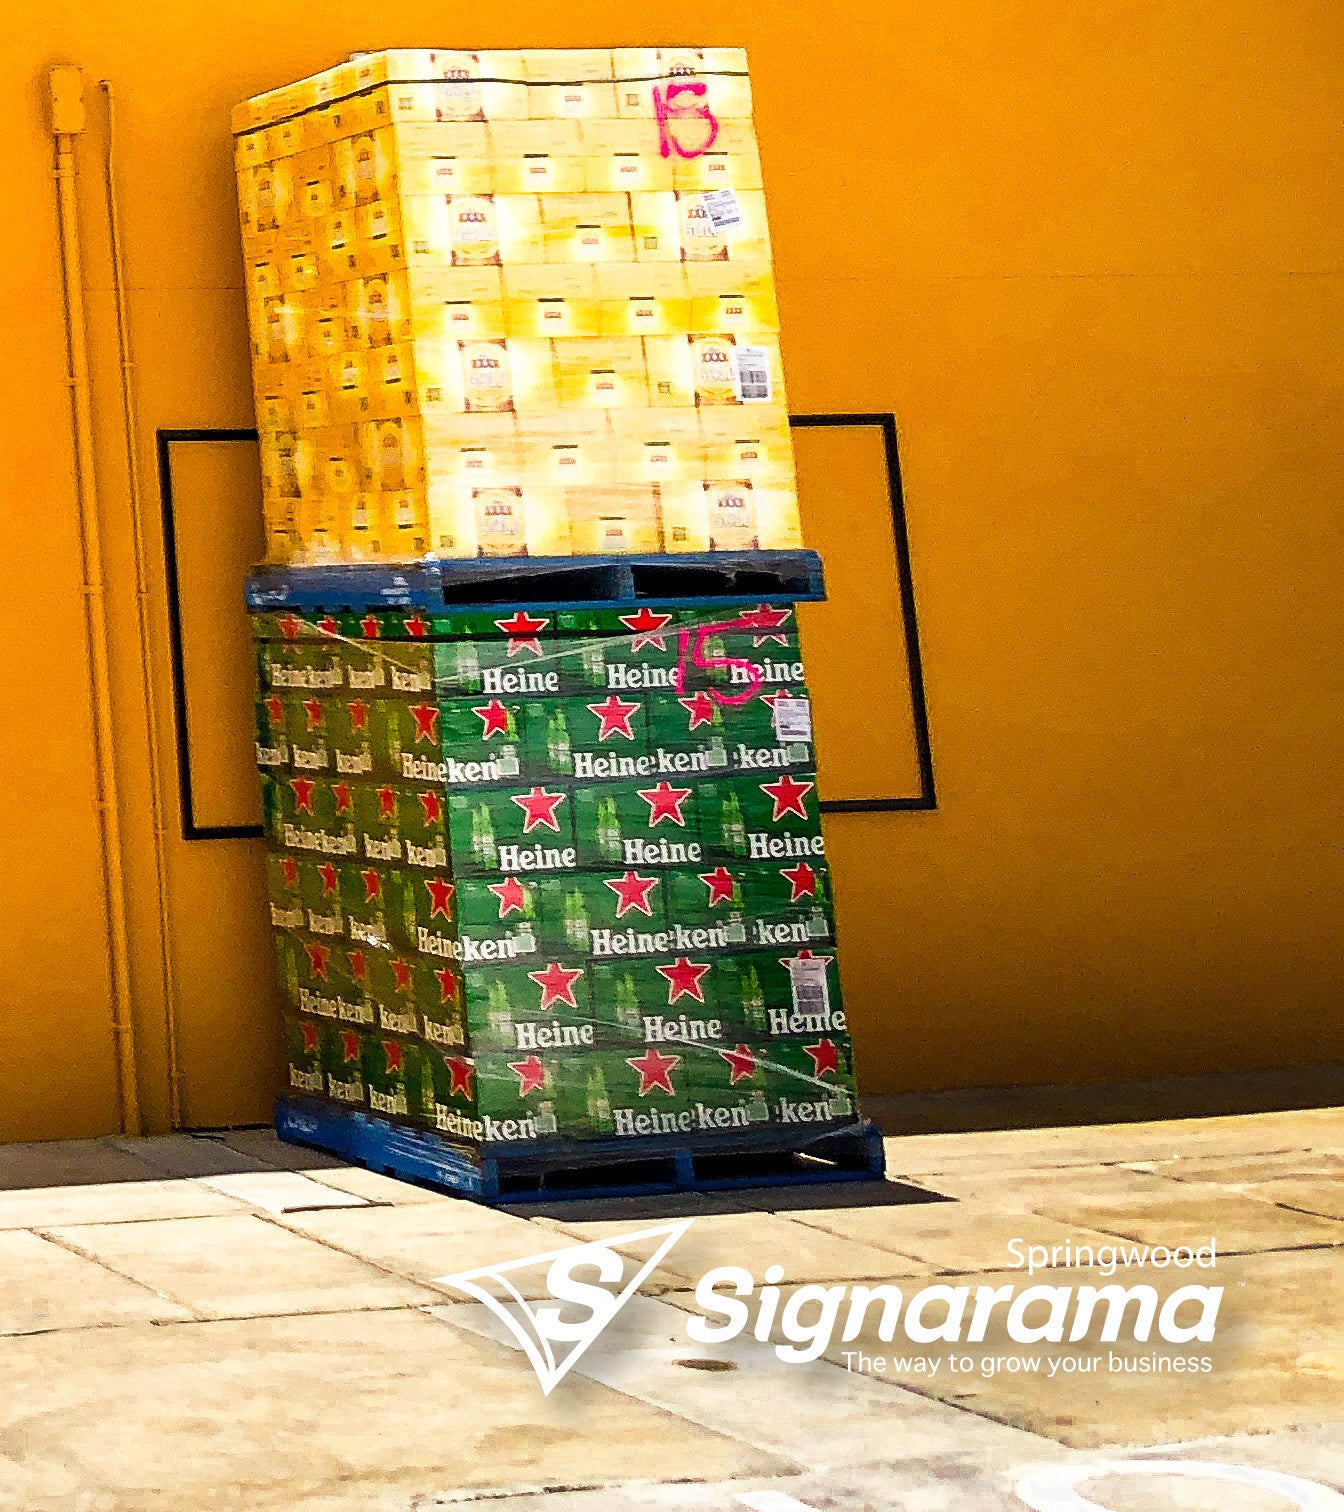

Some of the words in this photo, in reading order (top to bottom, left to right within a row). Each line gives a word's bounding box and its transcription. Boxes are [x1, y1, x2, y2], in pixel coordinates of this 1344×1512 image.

[653, 83, 718, 158] 15
[676, 614, 761, 705] 15
[498, 845, 576, 871] Heine
[624, 838, 701, 864] Heine
[516, 1020, 594, 1049] Heine
[643, 1015, 722, 1042] Heine
